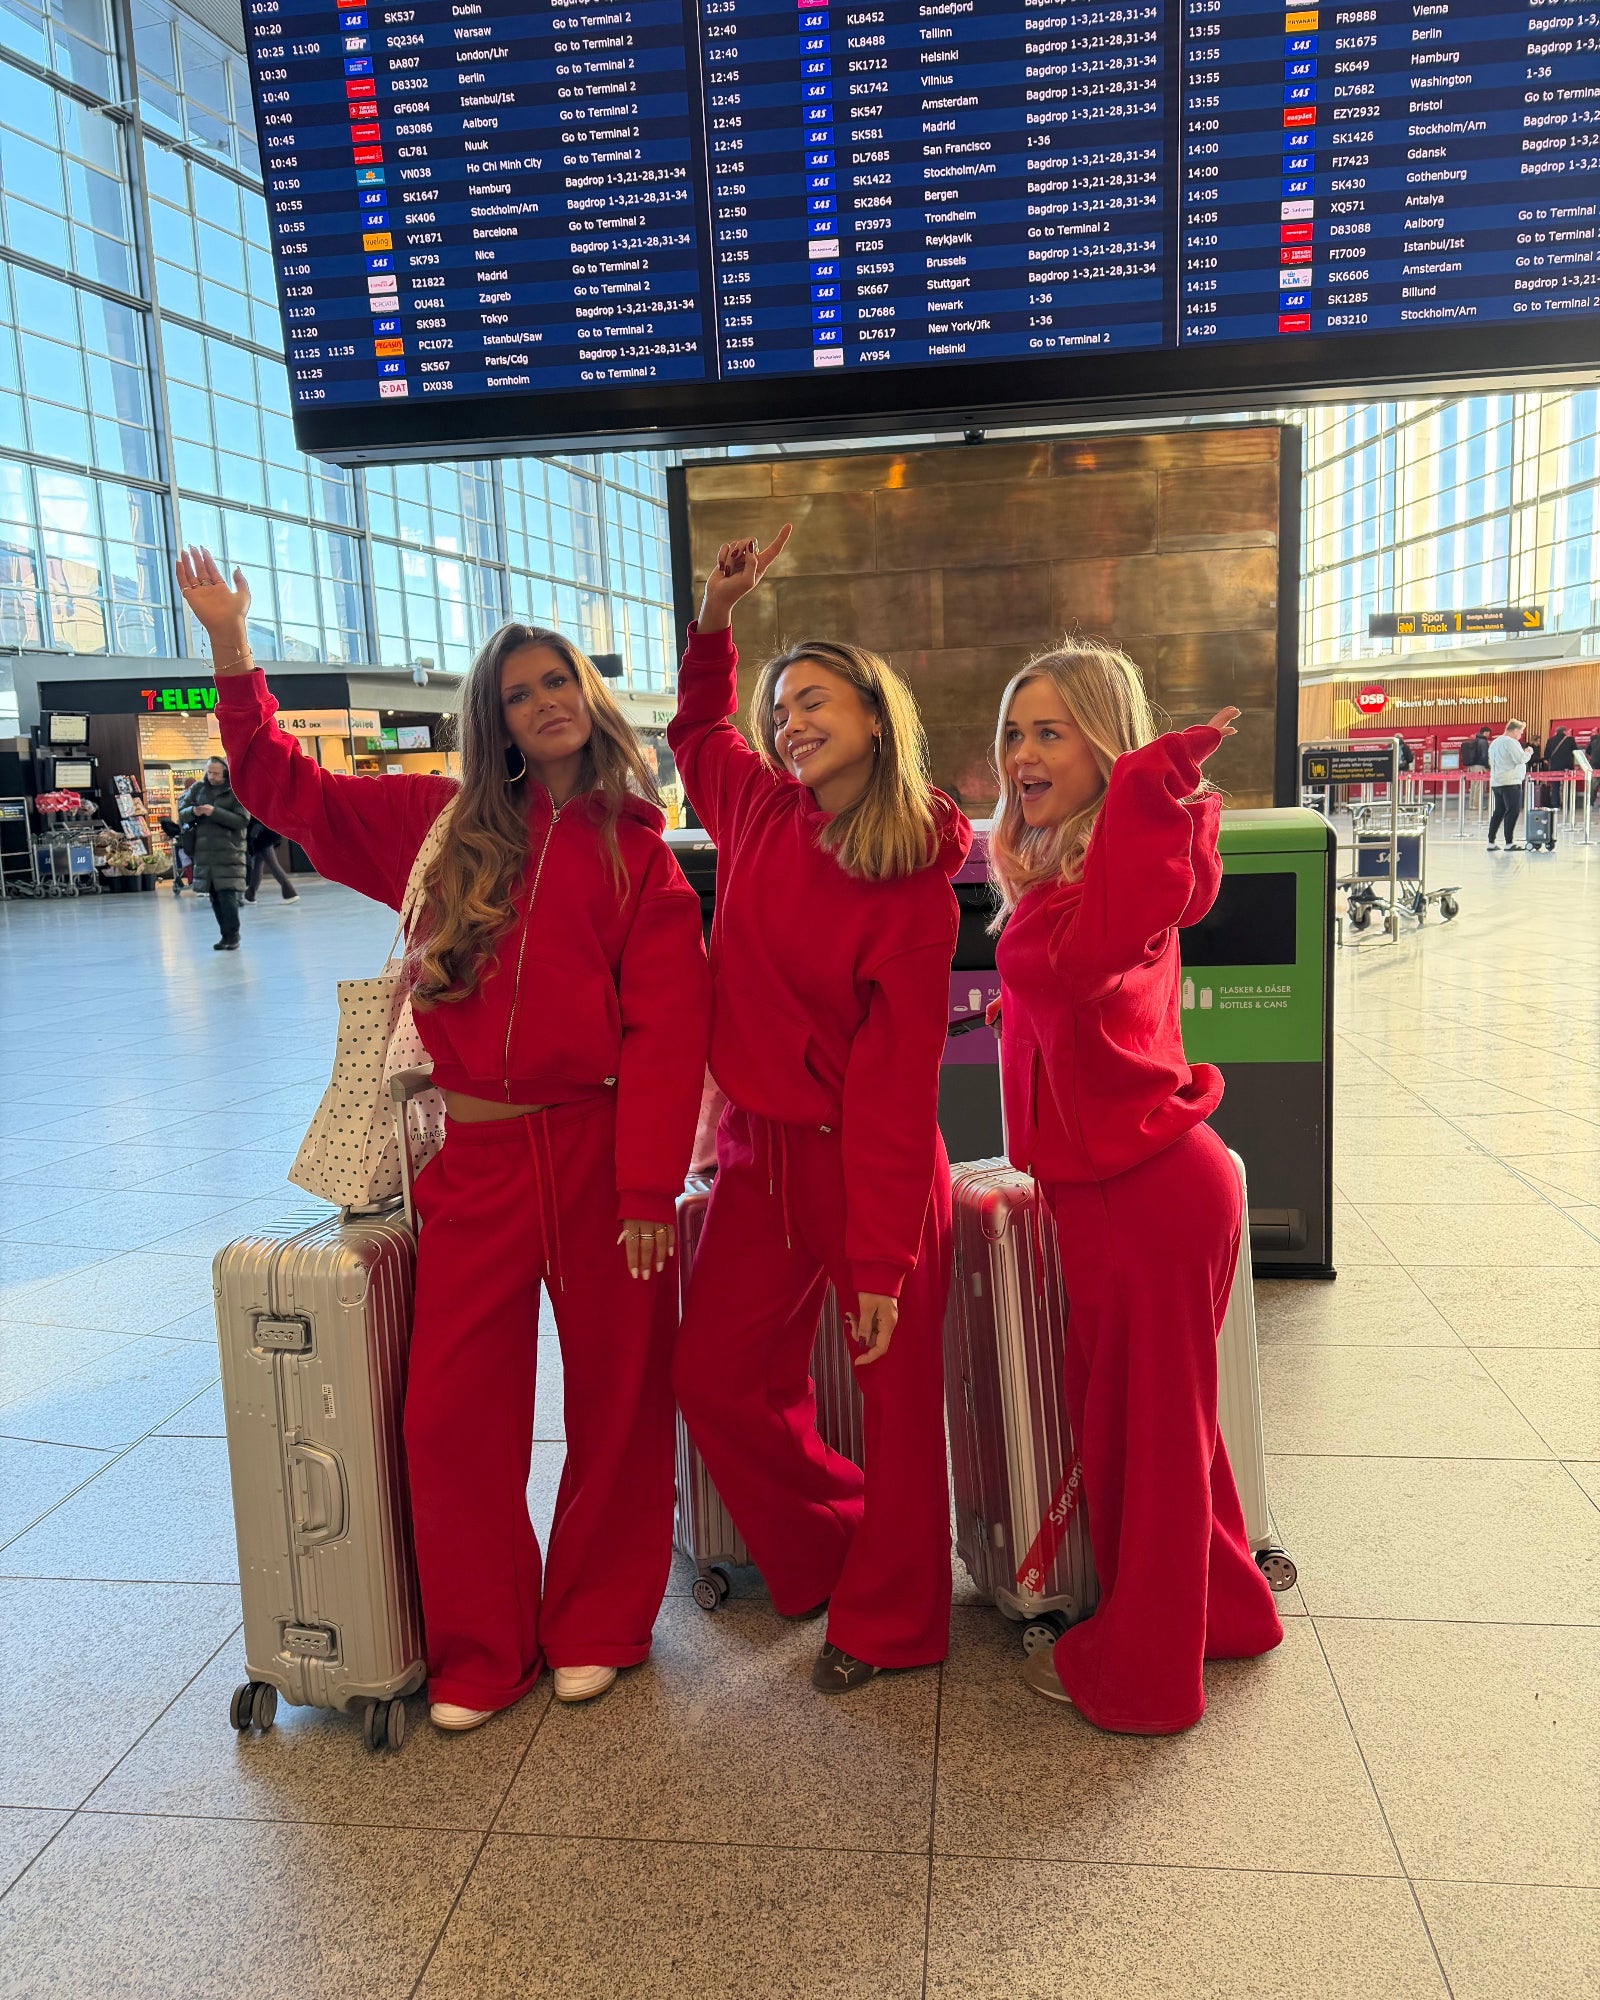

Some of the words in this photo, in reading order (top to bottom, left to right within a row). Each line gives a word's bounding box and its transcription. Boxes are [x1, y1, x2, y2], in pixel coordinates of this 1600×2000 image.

[257, 46, 284, 58] 10:25
[293, 43, 320, 55] 11:00
[345, 39, 366, 50] LOT
[387, 34, 424, 48] SQ2364
[454, 27, 491, 38] Warsaw
[553, 19, 566, 29] Go
[568, 18, 578, 28] to
[580, 12, 622, 26] Terminal
[626, 12, 631, 22] 2
[1190, 49, 1220, 61] 13:55
[1292, 40, 1311, 50] SAS
[1336, 35, 1377, 49] SK1675
[1412, 28, 1442, 40] Berlin
[1528, 17, 1574, 31] Bagdrop
[714, 116, 742, 128] 12:45
[809, 109, 826, 119] SAS
[851, 105, 882, 118] SK547
[922, 96, 978, 110] Amsterdam
[1026, 88, 1068, 101] Bagdrop
[1072, 79, 1156, 96] 1-3,21-28,31-34
[1189, 96, 1219, 108] 13:55
[1291, 88, 1310, 98] SAS
[1334, 84, 1374, 97] DL7682
[1410, 75, 1472, 88] Washington
[1527, 66, 1552, 78] 1-36
[1189, 120, 1219, 132] 14:00
[1334, 106, 1380, 120] EZY2932
[1410, 99, 1442, 112] Bristol
[1525, 92, 1539, 102] Go
[1543, 91, 1554, 101] to
[716, 162, 744, 174] 12:45
[811, 155, 828, 164] SAS
[853, 151, 890, 163] DL7685
[923, 146, 942, 155] San
[945, 142, 991, 153] Francisco
[1028, 135, 1050, 146] 1-36
[276, 200, 302, 212] 10:55
[365, 194, 381, 203] SAS
[403, 190, 438, 202] SK1647
[469, 184, 511, 195] Hamburg
[566, 176, 604, 188] Bagdrop
[607, 168, 686, 184] 1-3,21-28,31-34
[1188, 212, 1217, 224] 14:05
[1331, 200, 1365, 214] XQ571
[1405, 194, 1444, 206] Antalya
[281, 243, 308, 254] 10:55
[365, 236, 389, 247] vueling
[407, 233, 442, 244] VY1871
[473, 227, 518, 238] Barcelona
[569, 222, 582, 231] Go
[584, 220, 594, 230] to
[596, 216, 636, 228] Terminal
[640, 216, 646, 226] 2
[721, 251, 749, 262] 12:55
[856, 240, 884, 252] FI205
[926, 232, 972, 246] Reykjavik
[1028, 228, 1041, 237] Go
[1044, 227, 1054, 236] to
[1057, 222, 1100, 235] Terminal
[1104, 222, 1110, 231] 2
[1188, 280, 1216, 292] 14:15
[1282, 277, 1300, 285] KLM
[1329, 270, 1369, 282] SK6606
[1402, 262, 1462, 275] Amsterdam
[1516, 257, 1530, 266] Go
[1534, 256, 1544, 265] to
[1547, 251, 1593, 264] Terminal
[726, 337, 754, 348] 12:55
[819, 332, 836, 340] SAS
[860, 328, 896, 340] DL7617
[928, 324, 948, 333] New
[951, 320, 990, 332] York/Jfk
[1030, 315, 1052, 326] 1-36
[1187, 325, 1216, 336] 14:20
[1328, 314, 1368, 326] D83210
[1401, 306, 1476, 320] Stockholm/Arn
[1513, 303, 1527, 312] Go
[1531, 302, 1541, 310] to
[1544, 297, 1590, 310] Terminal
[294, 348, 320, 359] 11:25
[328, 346, 354, 356] 11:35
[419, 339, 453, 350] PC1072
[483, 333, 542, 345] Istanbul/Saw
[578, 329, 590, 338] Go
[593, 328, 602, 337] to
[604, 324, 644, 336] Terminal
[647, 324, 653, 333] 2
[728, 359, 755, 370] 13:00
[860, 350, 890, 362] AY954
[929, 343, 965, 355] Helsinki
[1030, 338, 1043, 348] Go
[1046, 338, 1056, 346] to
[1058, 334, 1100, 345] Terminal
[1104, 333, 1110, 342] 2
[299, 390, 325, 400] 11:30
[390, 384, 406, 392] DAT
[423, 381, 453, 391] DX038
[487, 375, 530, 386] Bornholm
[581, 371, 594, 380] Go
[596, 370, 606, 379] to
[608, 366, 647, 378] Terminal
[650, 366, 656, 375] 2
[1421, 613, 1443, 624] Spor
[1421, 623, 1447, 633] Track
[1454, 613, 1462, 632] 1
[1360, 694, 1385, 705] DSB
[1423, 699, 1435, 707] for
[292, 719, 306, 728] 43
[76, 856, 86, 864] SAS
[1220, 986, 1254, 994] FLASKER
[1220, 1001, 1253, 1009] BOTTLES
